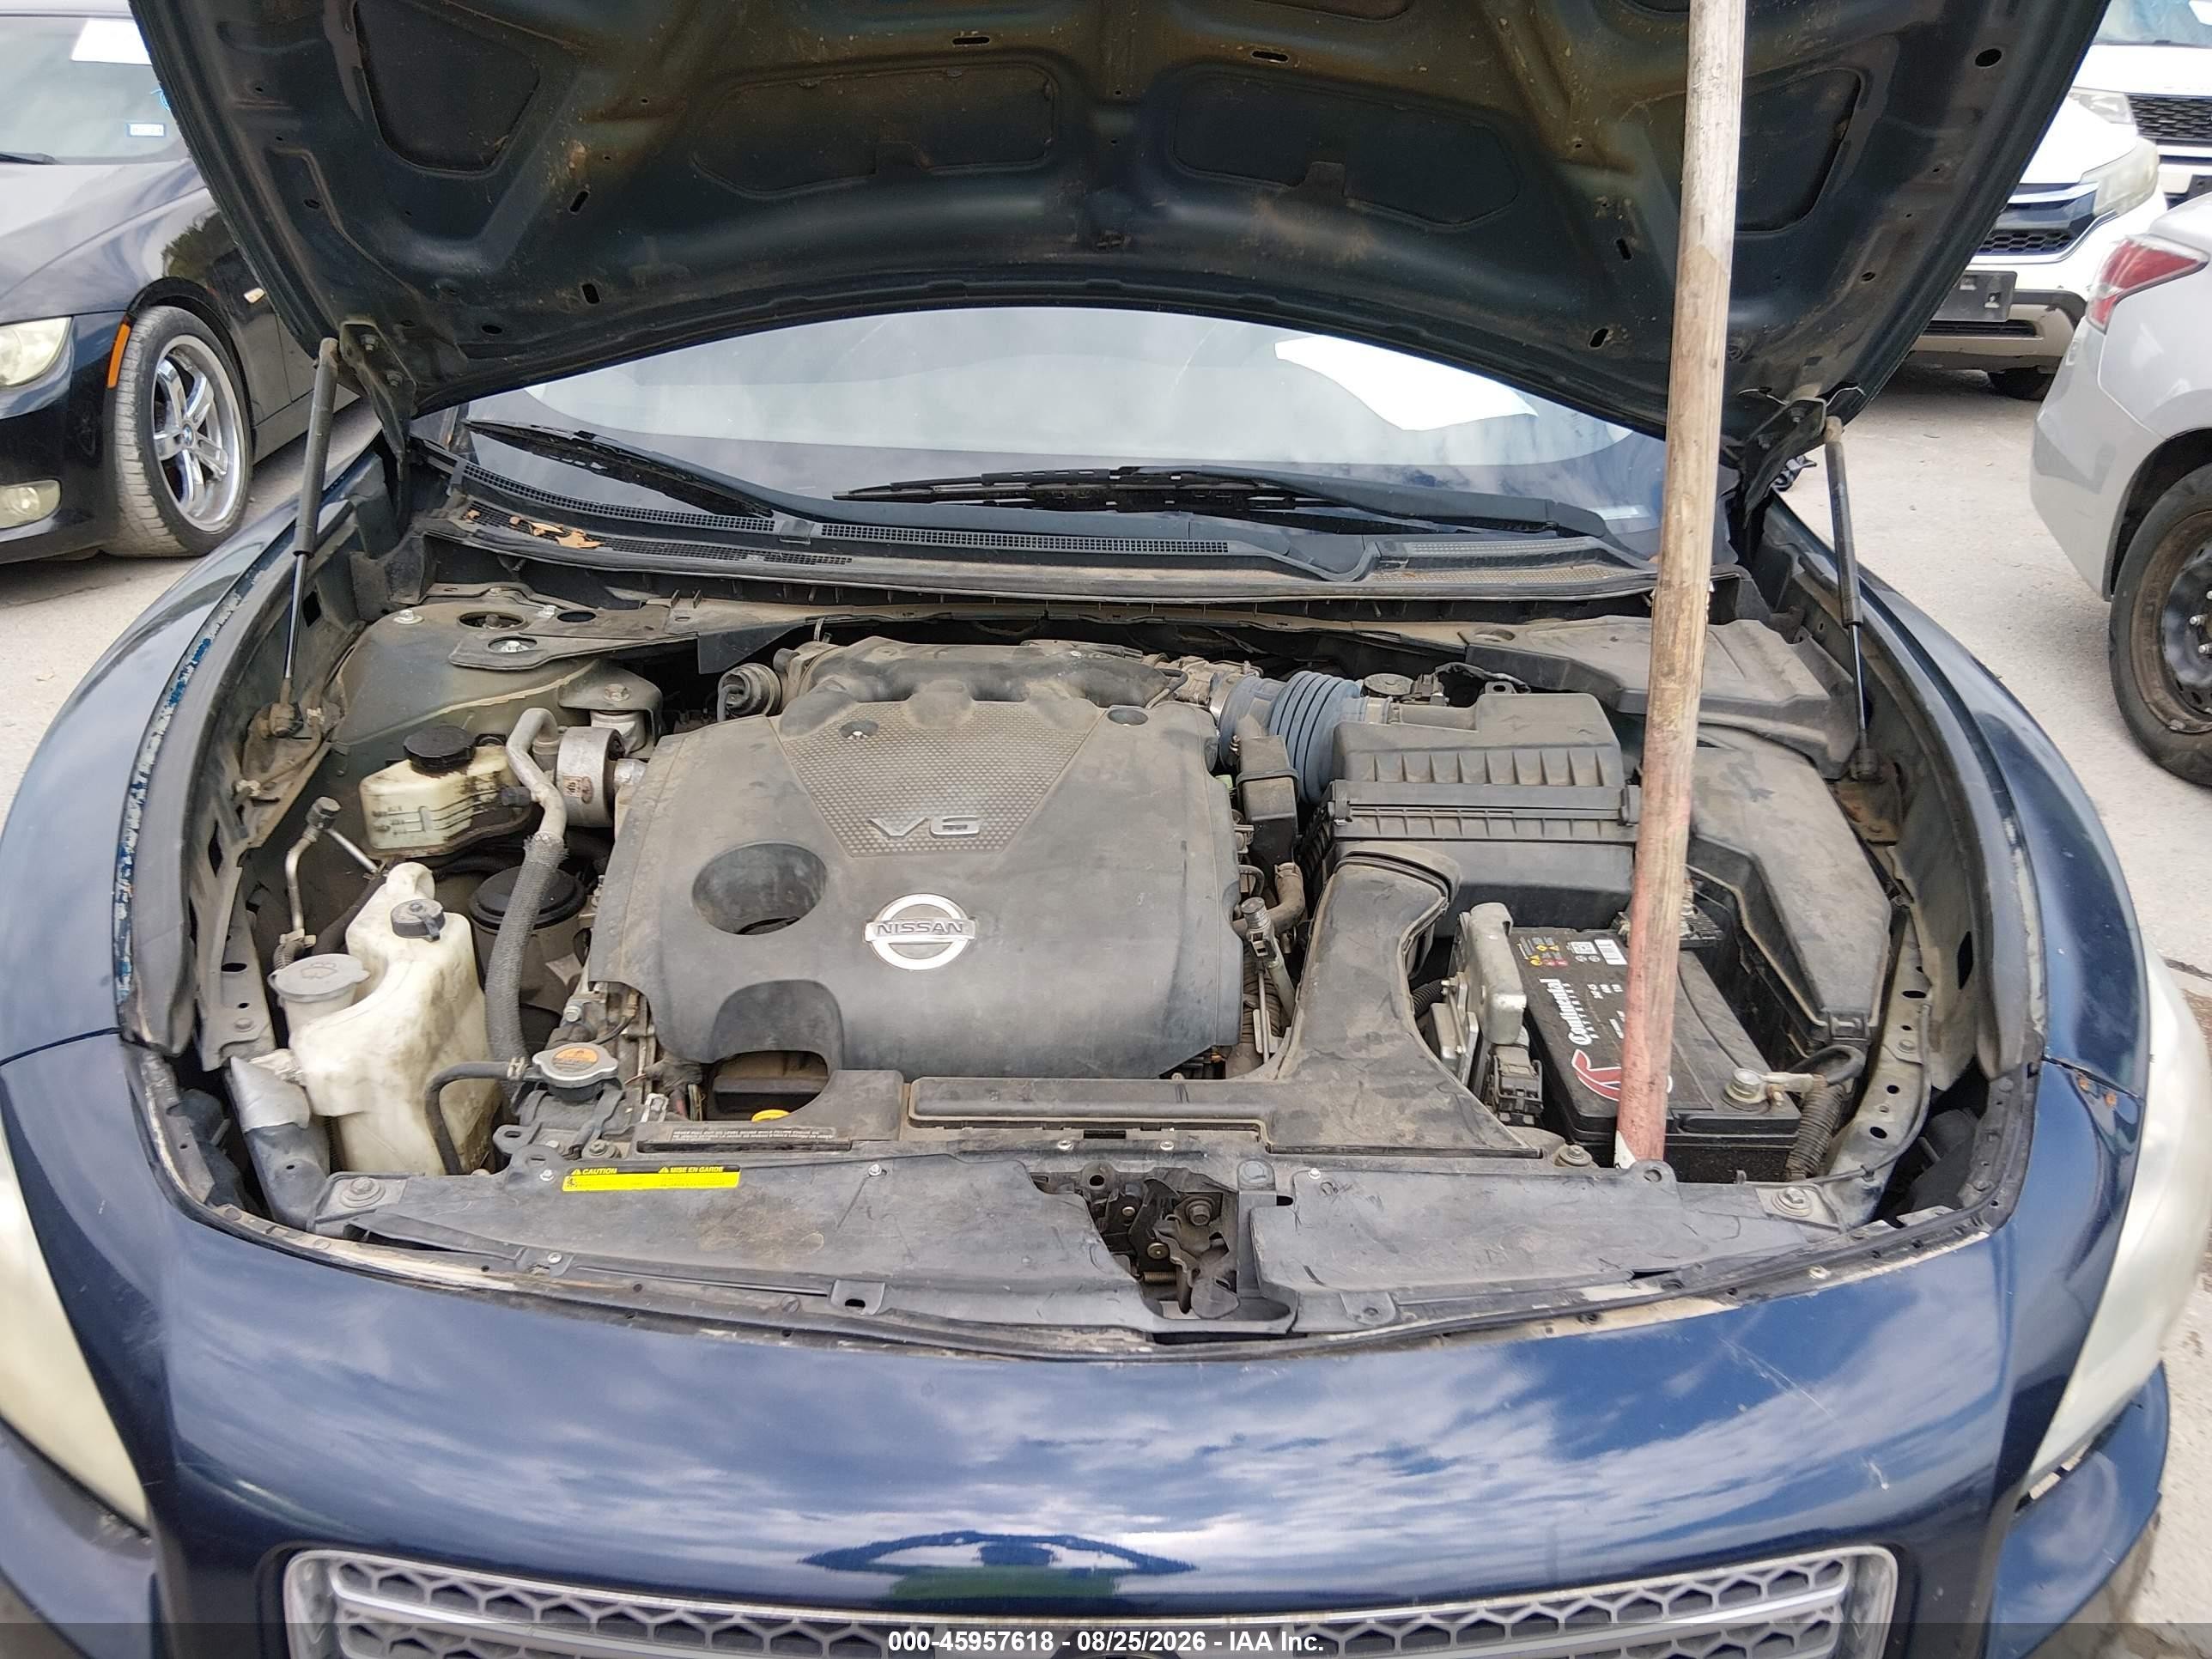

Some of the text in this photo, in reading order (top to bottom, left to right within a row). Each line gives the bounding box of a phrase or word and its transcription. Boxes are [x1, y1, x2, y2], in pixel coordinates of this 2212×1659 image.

[867, 816, 981, 839] V6
[877, 921, 963, 934] NISSAN
[1539, 978, 1592, 1045] Continental
